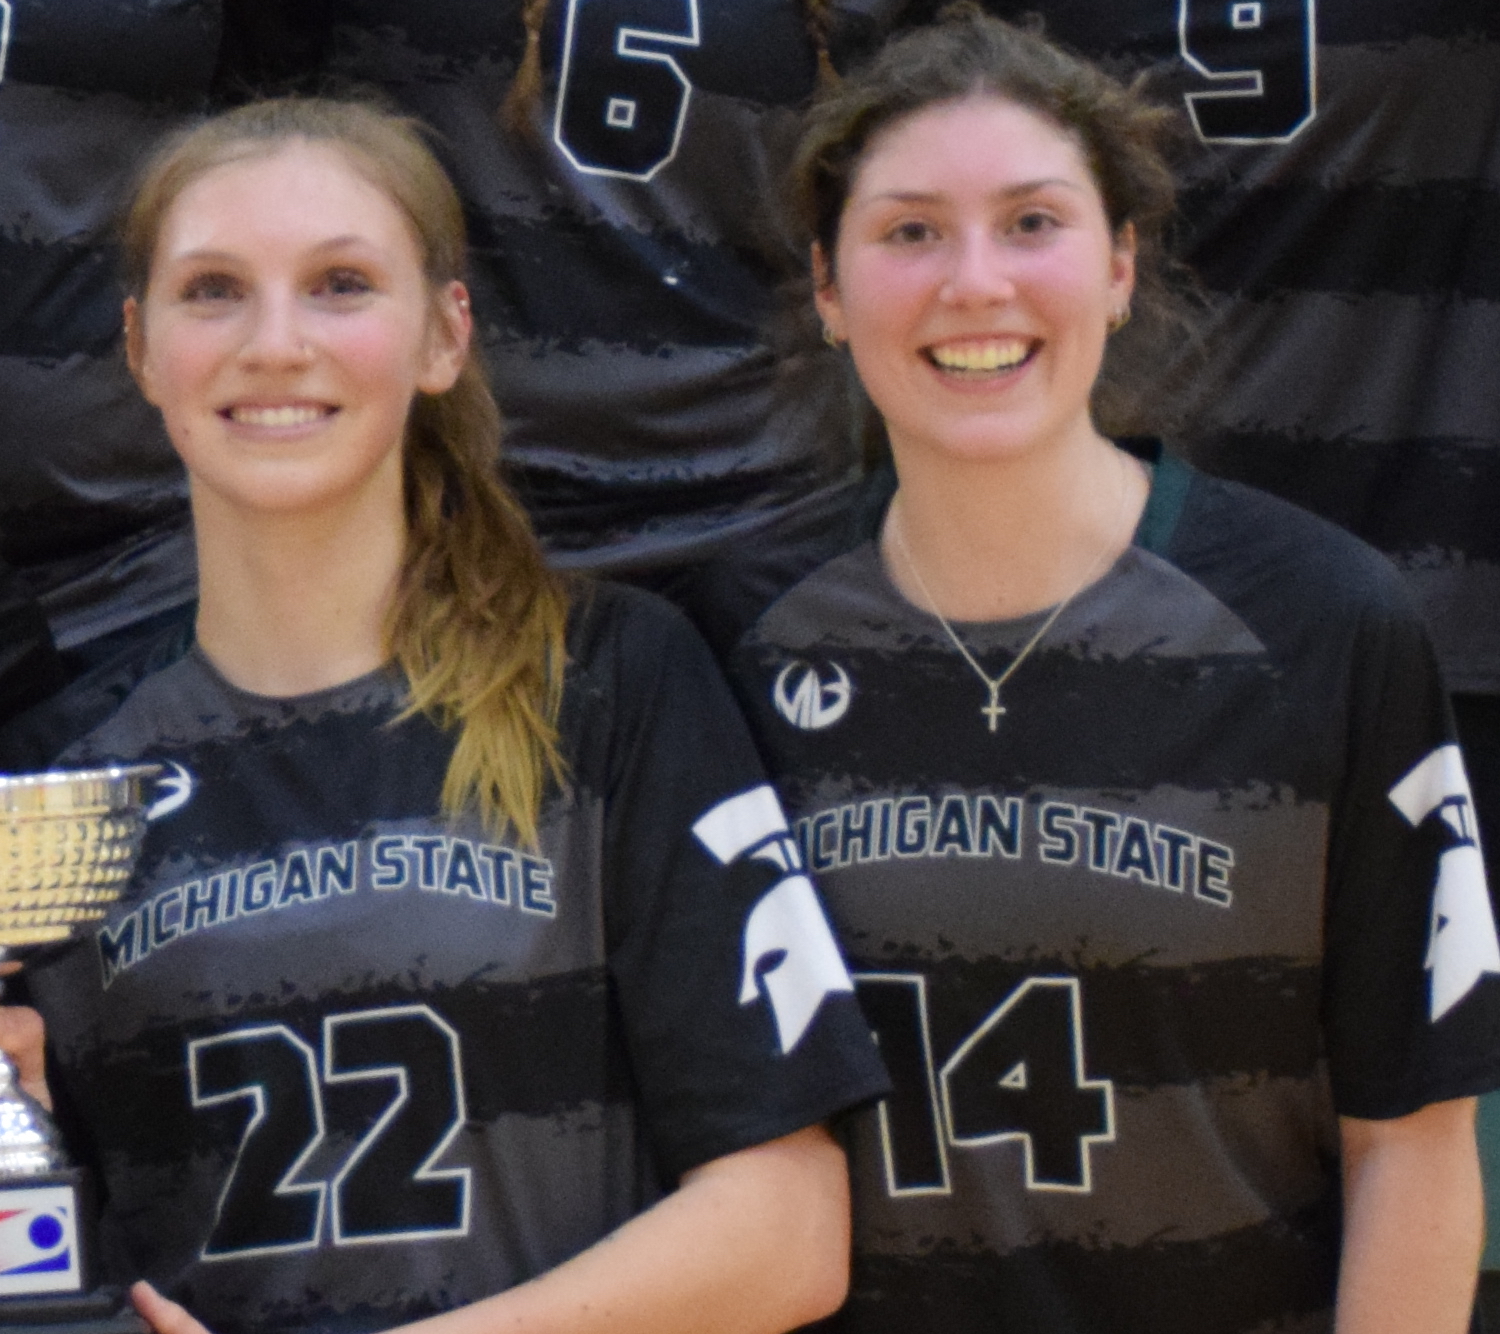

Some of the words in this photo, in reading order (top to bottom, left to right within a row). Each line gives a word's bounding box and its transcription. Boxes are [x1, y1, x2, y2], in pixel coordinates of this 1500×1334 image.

[97, 841, 357, 990] MICHIGAN
[372, 835, 556, 917] STATE
[794, 795, 1022, 873] ICHIGAN
[1040, 801, 1234, 907] STATE
[188, 1004, 471, 1262] 22
[852, 974, 1115, 1197] 14
